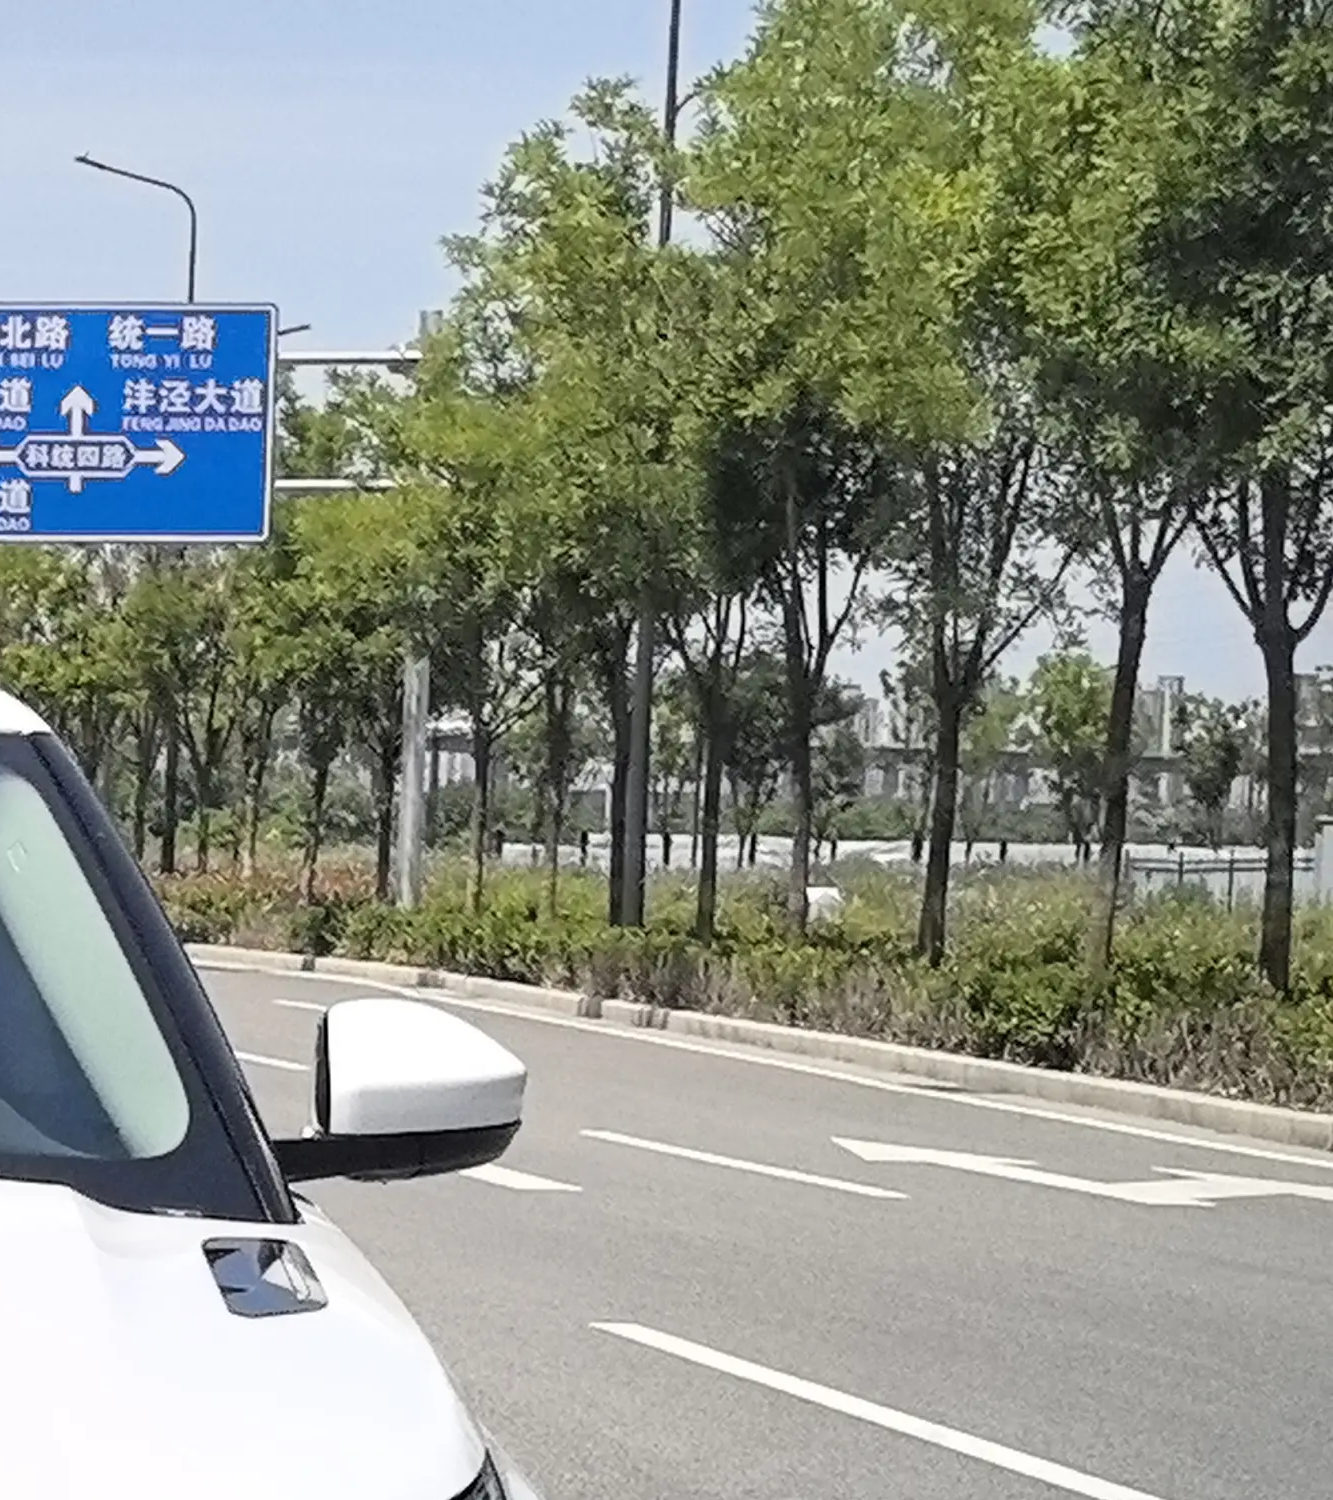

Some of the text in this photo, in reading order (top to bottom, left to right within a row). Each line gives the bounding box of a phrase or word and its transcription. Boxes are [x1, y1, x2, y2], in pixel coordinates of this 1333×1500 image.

[108, 315, 215, 350] 统一路
[41, 353, 64, 369] LU
[110, 354, 213, 369] TONG YI LU
[122, 377, 264, 414] 沣泾大道
[204, 416, 225, 432] DA
[228, 416, 263, 432] DAO
[24, 444, 127, 469] 科统四路
